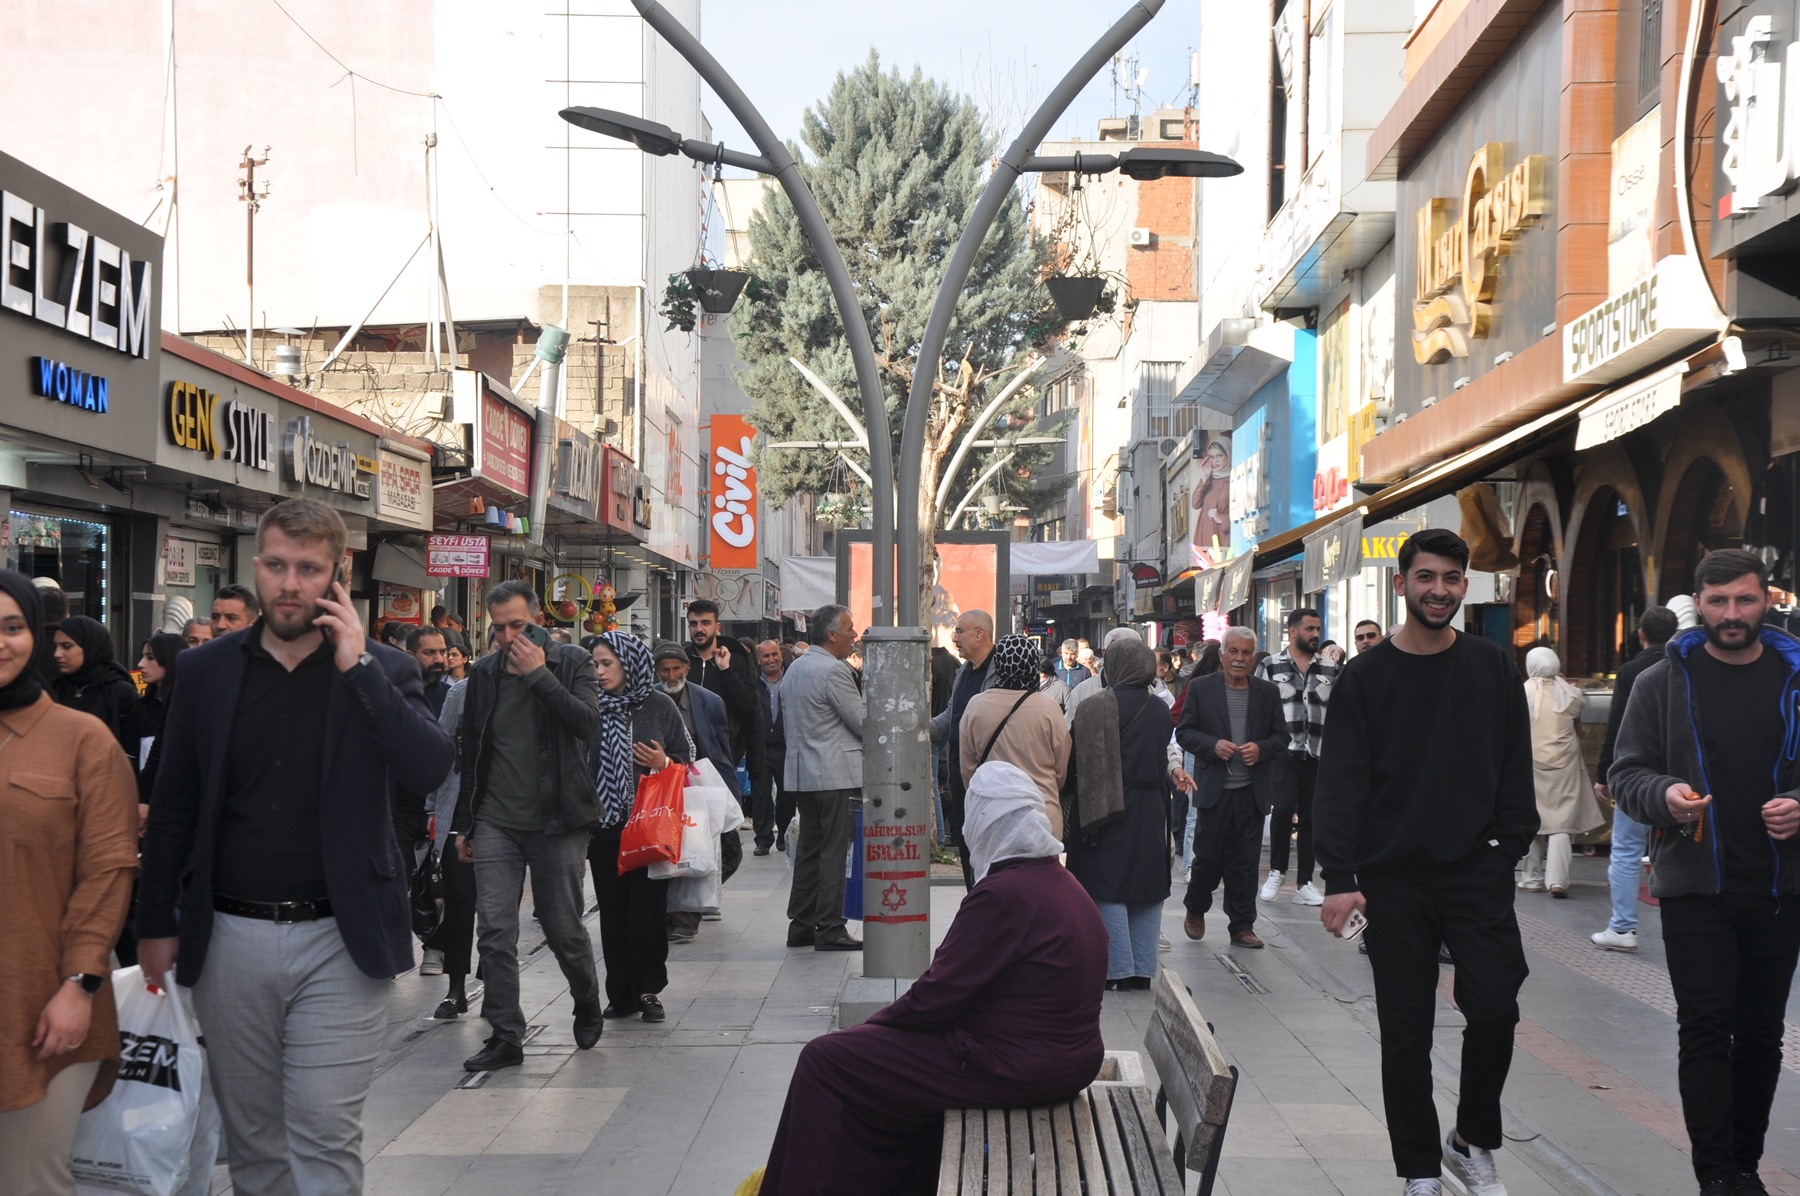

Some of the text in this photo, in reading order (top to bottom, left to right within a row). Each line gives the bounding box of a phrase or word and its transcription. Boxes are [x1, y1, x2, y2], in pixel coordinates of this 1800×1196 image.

[1, 189, 152, 360] ELZEM
[38, 356, 108, 413] WOMAN
[168, 380, 275, 472] GENÇ STYLE
[305, 427, 358, 495] ÖZDEMİR
[713, 436, 755, 547] Civil
[460, 566, 485, 574] DÖNER
[461, 537, 486, 546] USTA
[866, 840, 921, 862] İSRAİL
